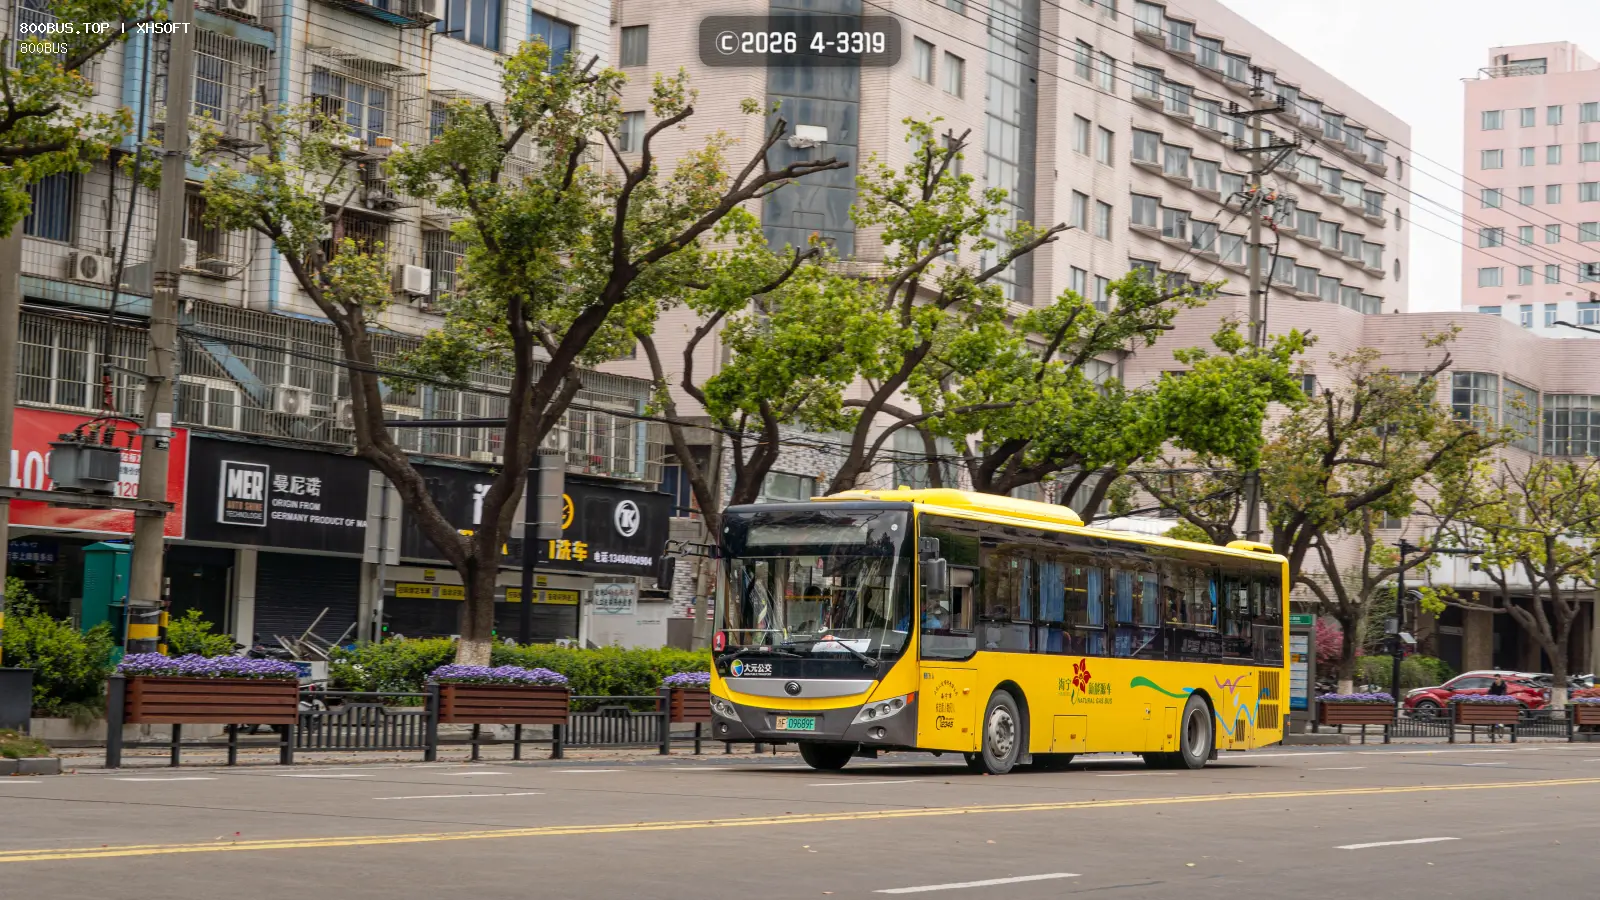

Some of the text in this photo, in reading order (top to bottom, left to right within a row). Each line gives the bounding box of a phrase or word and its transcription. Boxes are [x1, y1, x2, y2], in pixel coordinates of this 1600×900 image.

[227, 469, 264, 501] MER
[271, 498, 321, 511] ORIGIN FROM
[271, 511, 309, 523] GERMANY
[309, 515, 344, 526] PRODUCT
[344, 518, 355, 527] OF
[548, 539, 589, 562] 洗车
[744, 663, 773, 673] 大元公交
